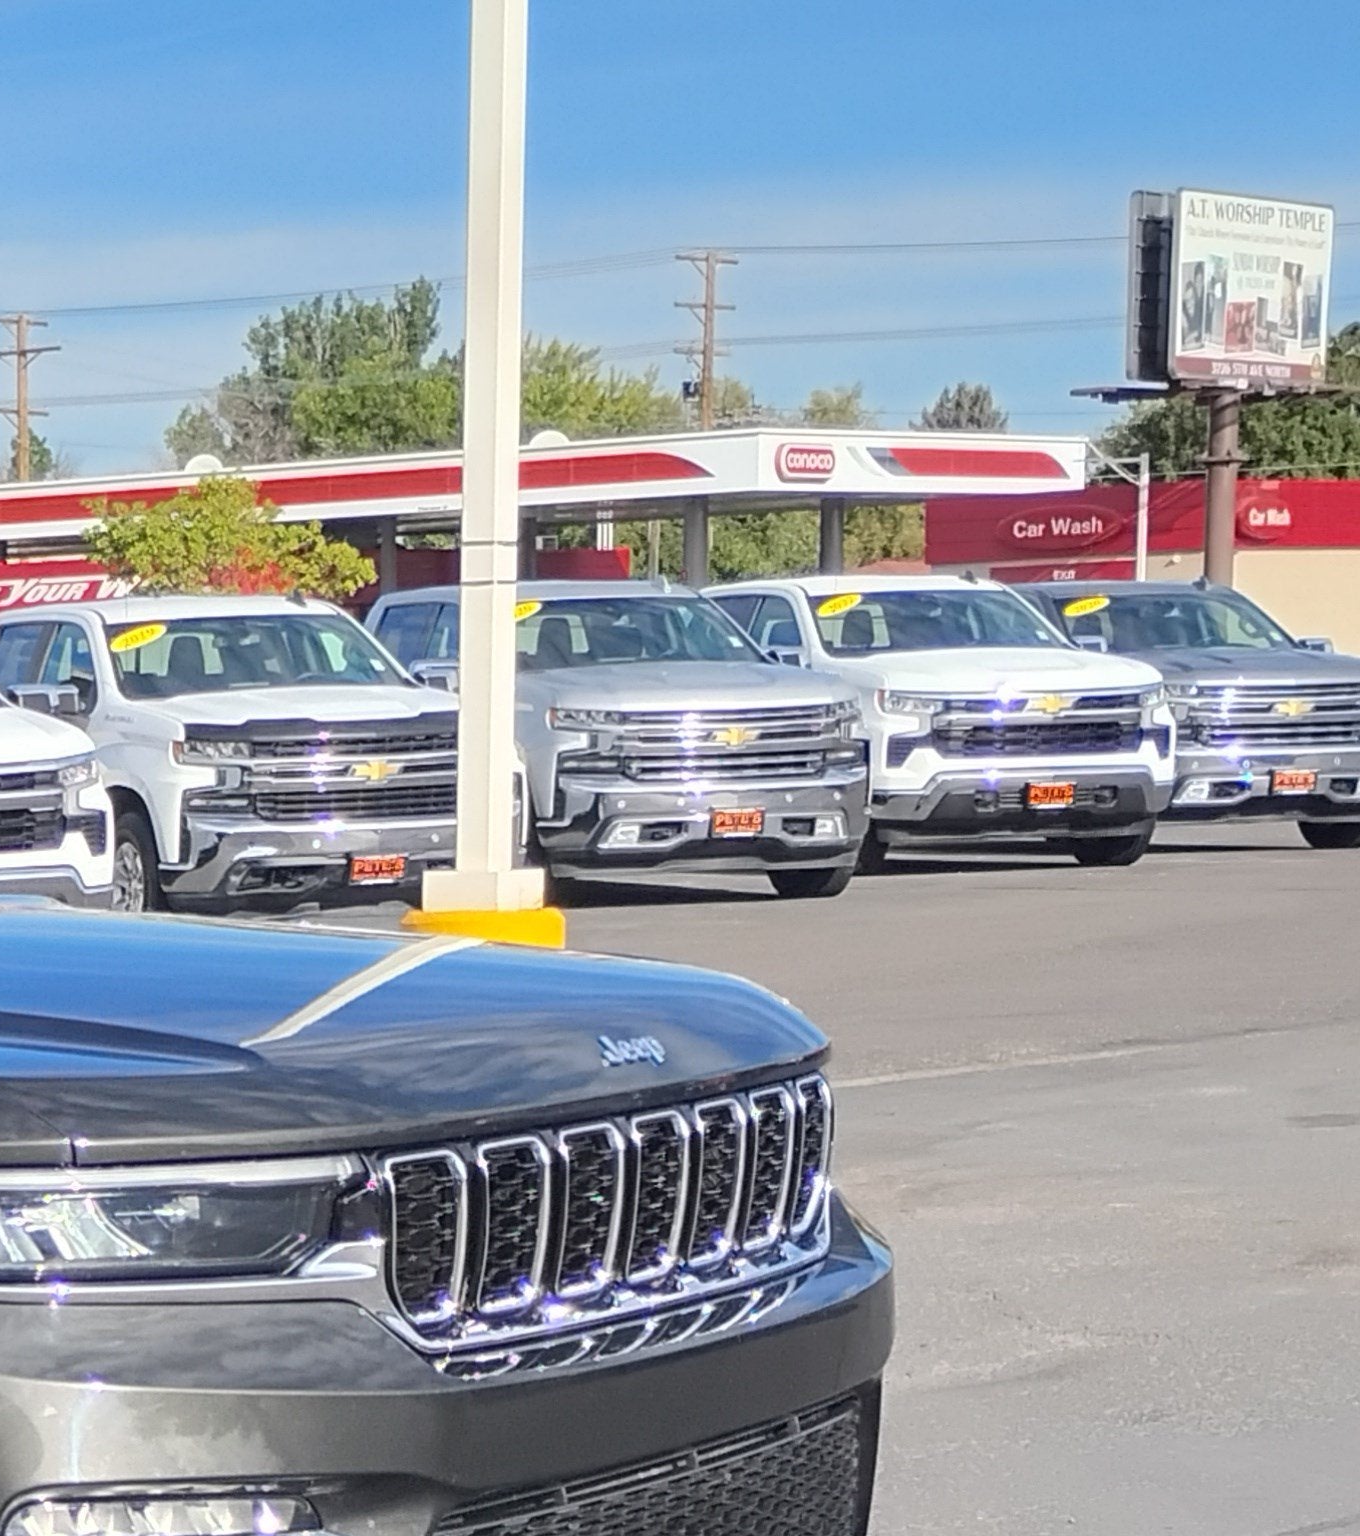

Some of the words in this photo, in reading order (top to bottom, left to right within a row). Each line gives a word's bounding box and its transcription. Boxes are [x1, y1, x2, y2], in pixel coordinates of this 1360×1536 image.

[1214, 200, 1275, 226] WORSHIP
[1278, 208, 1327, 233] TEMPLE
[1249, 507, 1266, 526] Car
[1266, 507, 1291, 526] Wash
[1013, 521, 1045, 538] Car
[1051, 516, 1104, 536] Wash
[1053, 569, 1076, 580] EXIT
